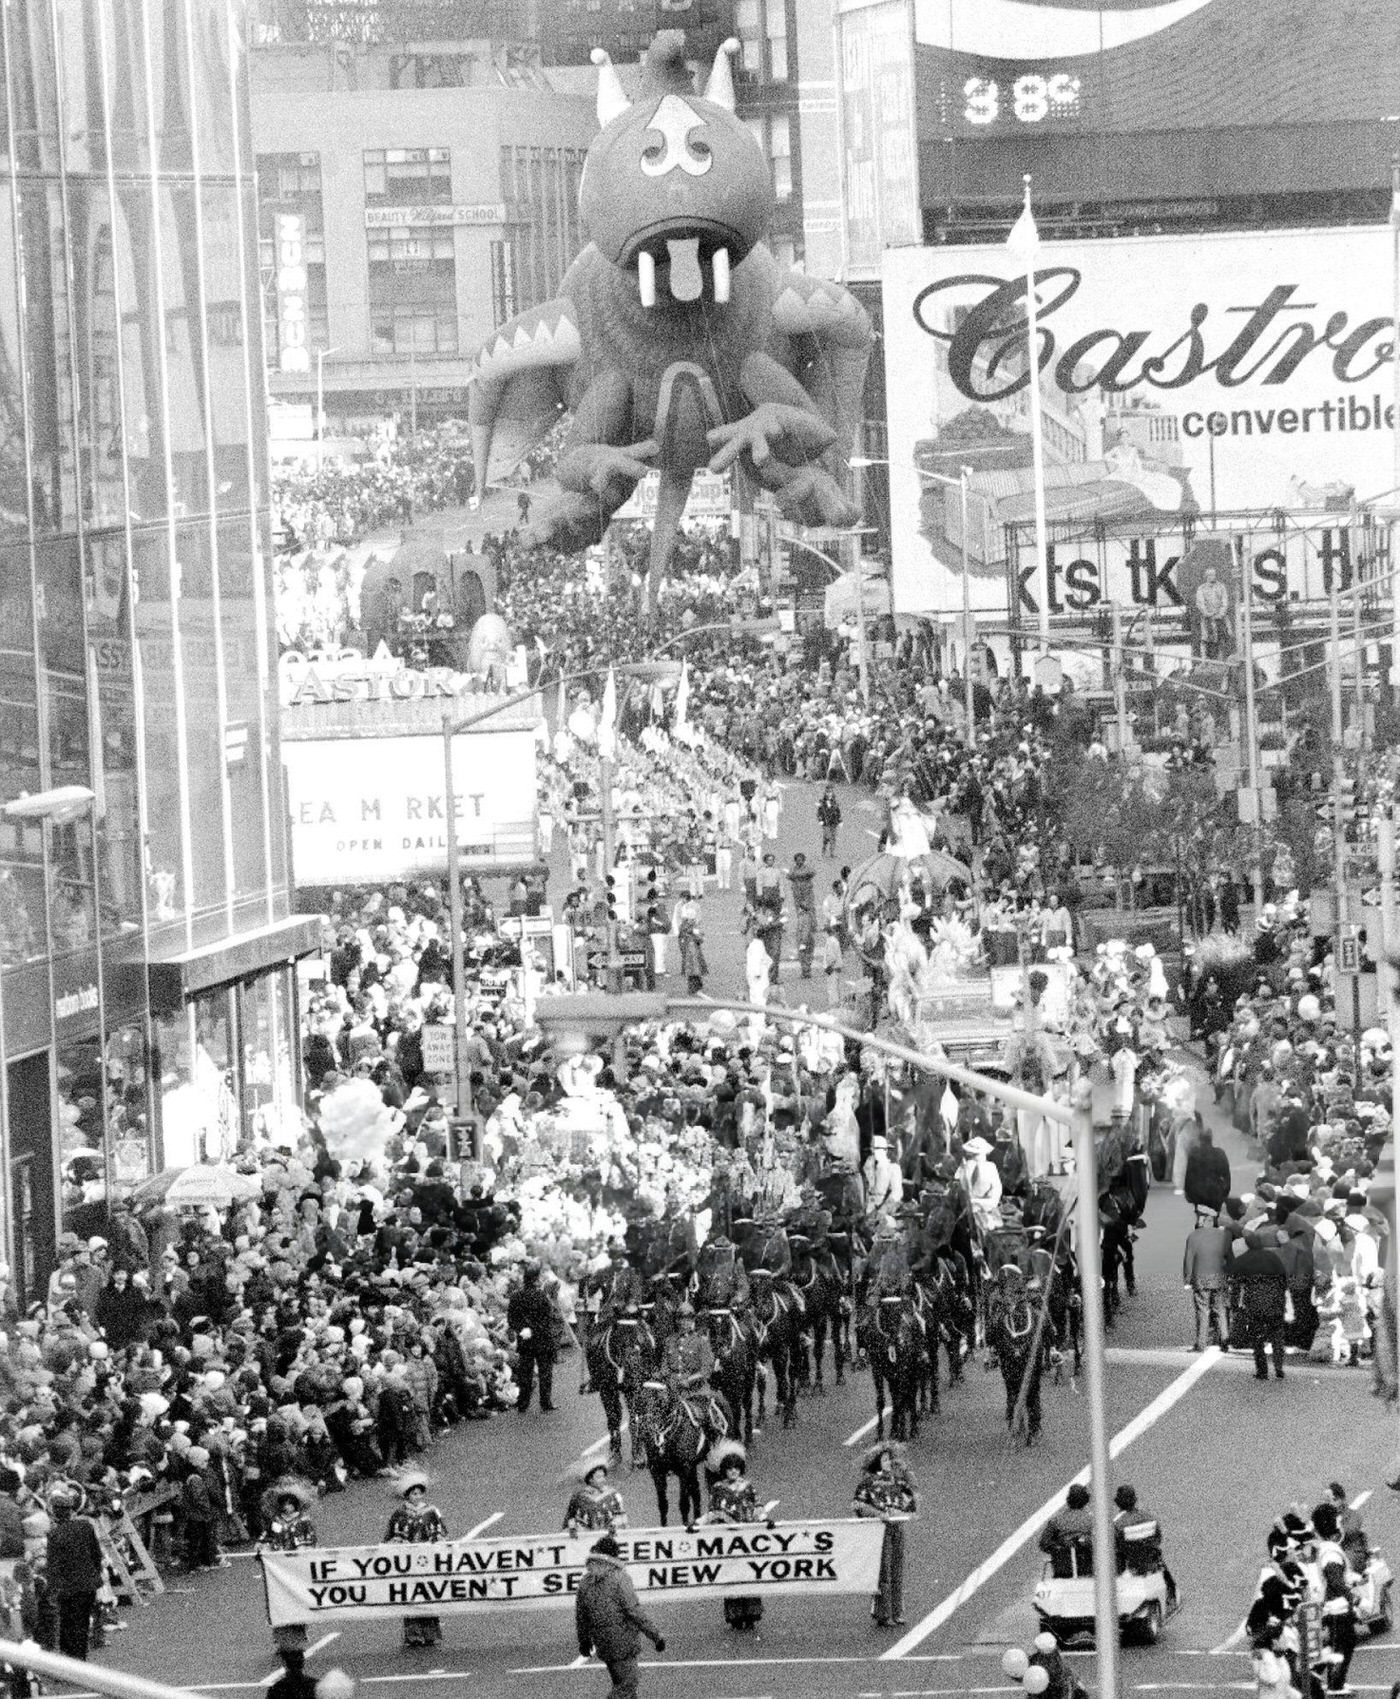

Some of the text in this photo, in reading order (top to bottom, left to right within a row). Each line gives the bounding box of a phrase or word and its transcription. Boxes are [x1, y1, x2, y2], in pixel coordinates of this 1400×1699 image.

[367, 211, 407, 223] BEAUTY
[457, 208, 500, 220] SCHOOL
[292, 667, 456, 704] ASTOR
[336, 838, 382, 852] OPEN
[310, 1560, 338, 1581] IF
[352, 1553, 412, 1578] YOU
[617, 1540, 673, 1562] EEN
[308, 1584, 367, 1607] YOU
[542, 1571, 582, 1593] SE
[648, 1563, 722, 1587] NEW
[748, 1557, 838, 1580] YORK
